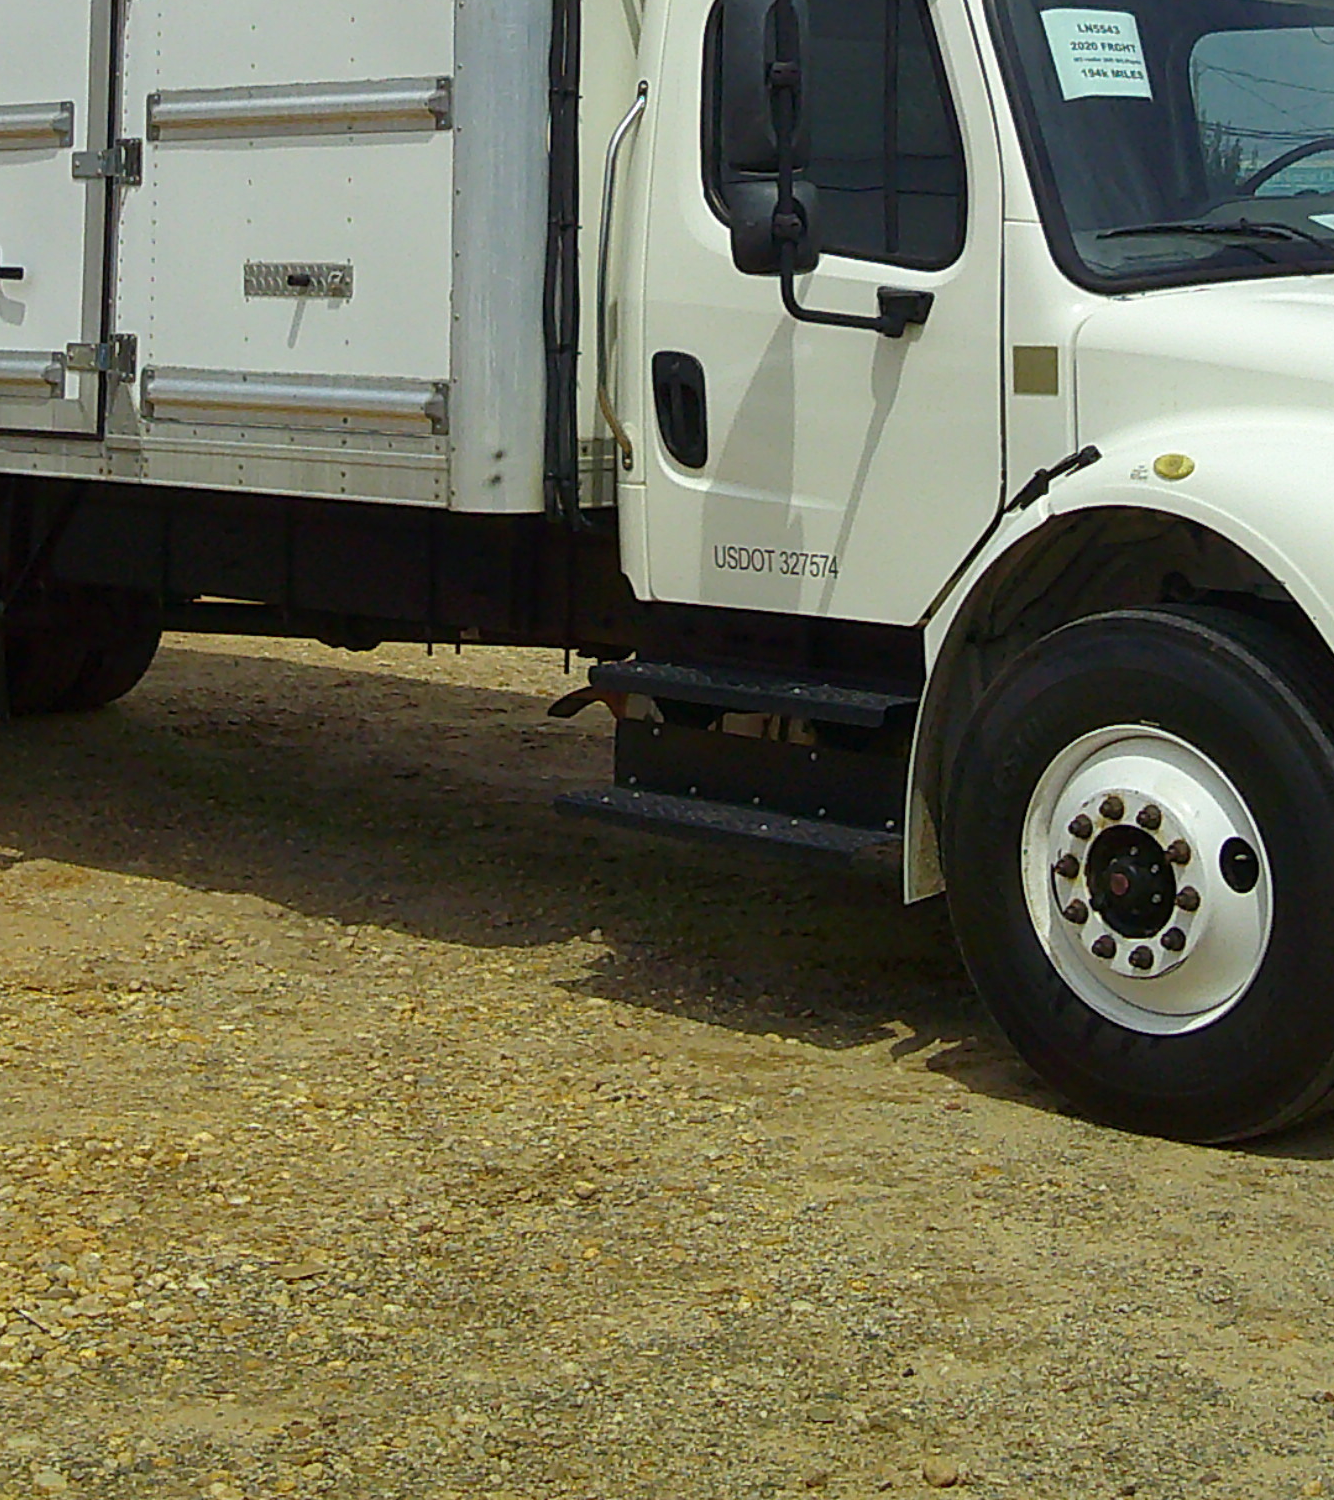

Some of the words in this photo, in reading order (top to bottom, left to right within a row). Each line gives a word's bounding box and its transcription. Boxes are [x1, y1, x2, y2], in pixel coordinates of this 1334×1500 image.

[1069, 41, 1098, 51] 2020
[1111, 68, 1145, 80] MILES
[714, 545, 776, 572] USDOT
[779, 551, 839, 579] 327574
